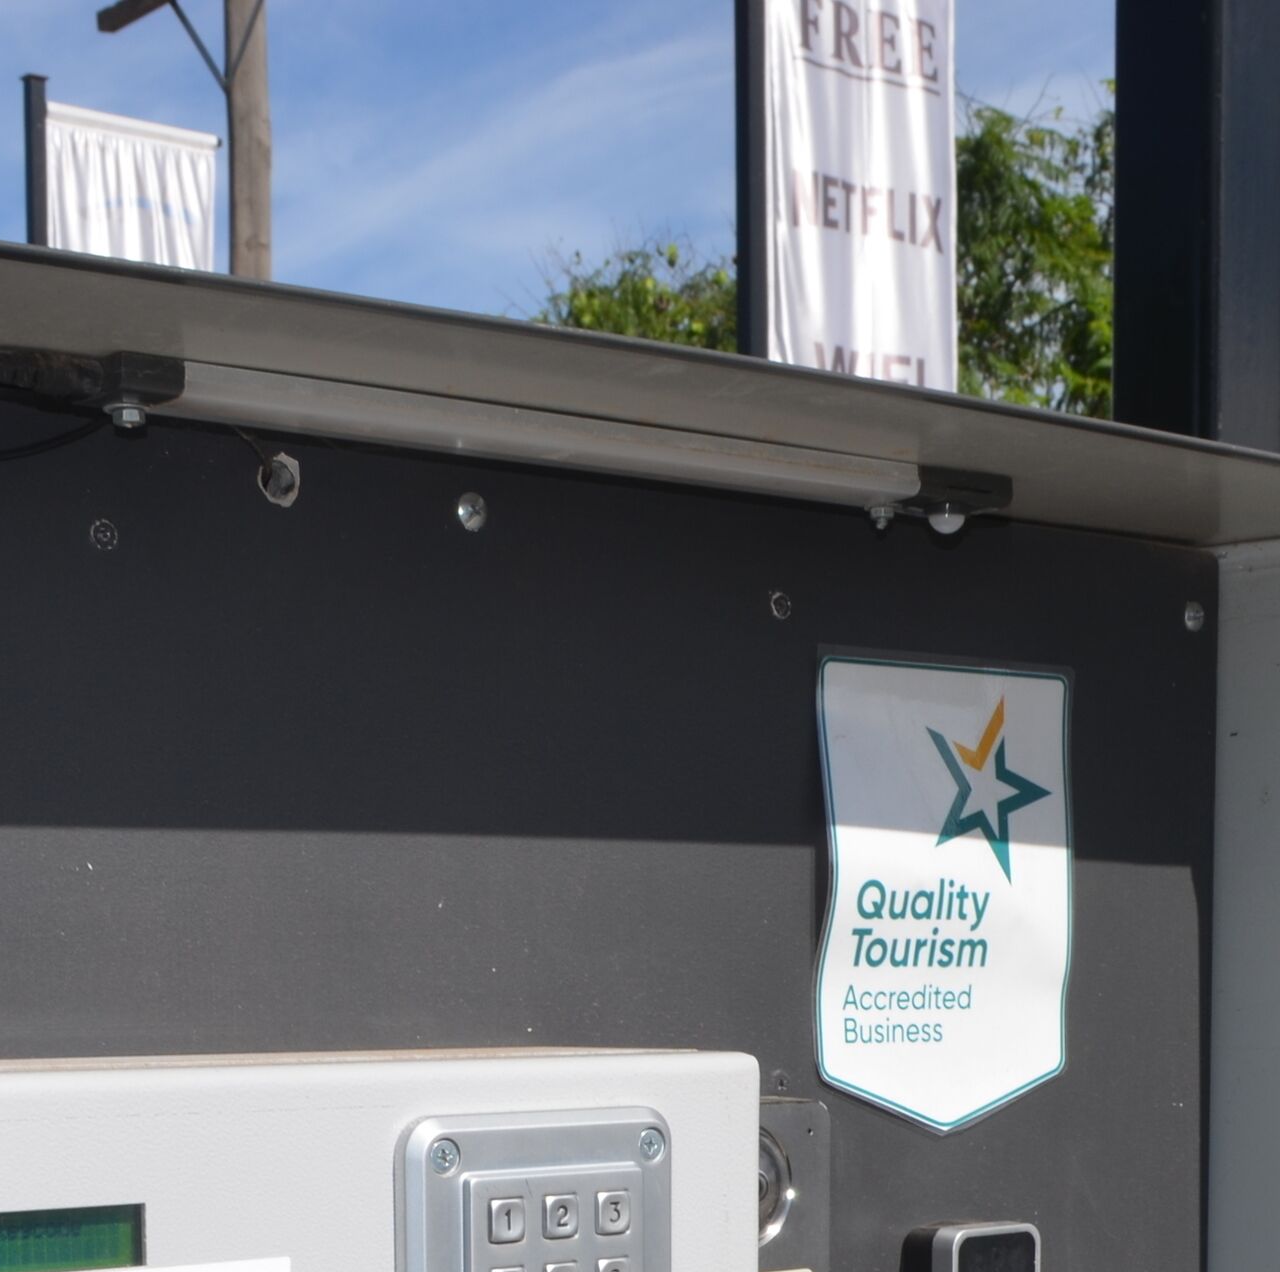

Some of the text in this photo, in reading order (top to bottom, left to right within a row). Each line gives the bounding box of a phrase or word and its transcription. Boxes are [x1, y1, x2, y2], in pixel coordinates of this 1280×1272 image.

[799, 0, 939, 83] FREE
[792, 168, 943, 255] NETFLIX
[856, 878, 990, 931] Quality
[851, 927, 988, 967] Tourism
[842, 984, 972, 1011] Accredited
[844, 1017, 943, 1044] Business
[556, 1204, 569, 1228] 2
[609, 1201, 621, 1223] 3
